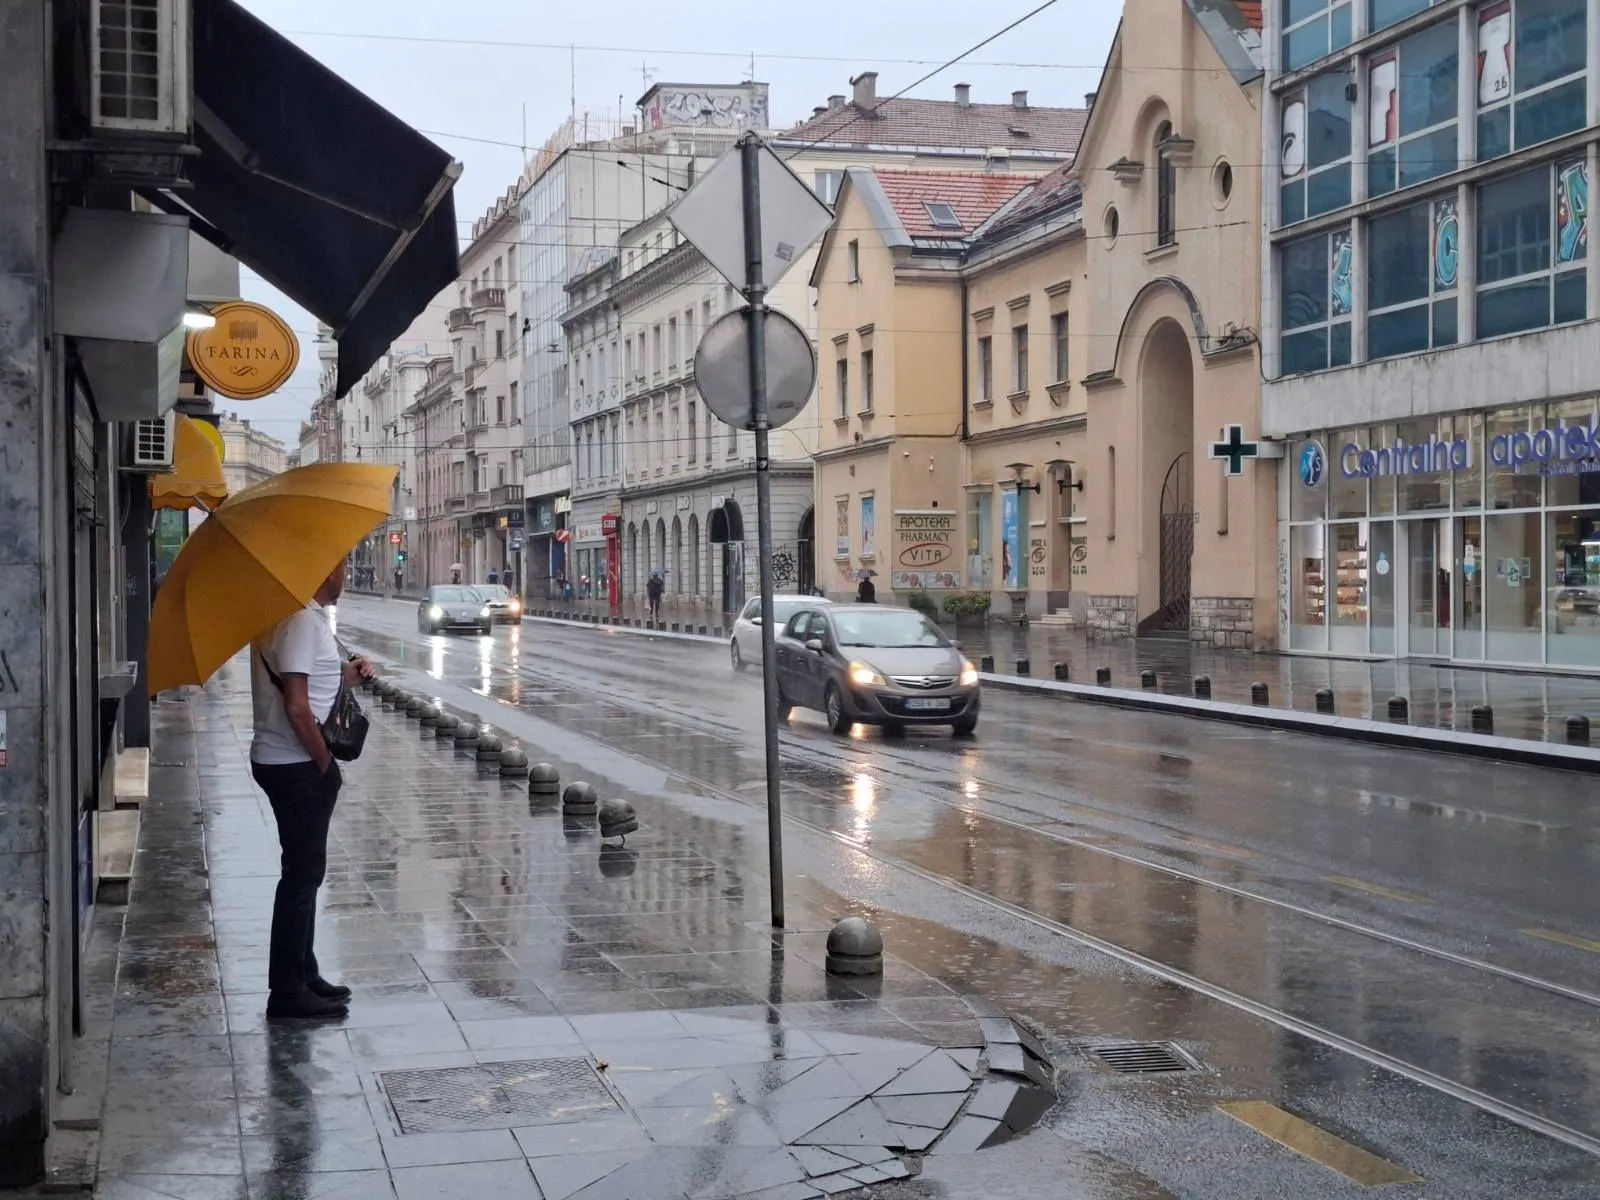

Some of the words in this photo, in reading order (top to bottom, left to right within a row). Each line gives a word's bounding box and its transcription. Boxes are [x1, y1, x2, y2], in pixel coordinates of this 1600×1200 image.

[206, 345, 281, 361] FARINA
[1341, 433, 1469, 480] Centralna
[900, 516, 951, 529] APOTEKA
[900, 532, 950, 542] PHARMACY
[910, 549, 942, 561] VITA
